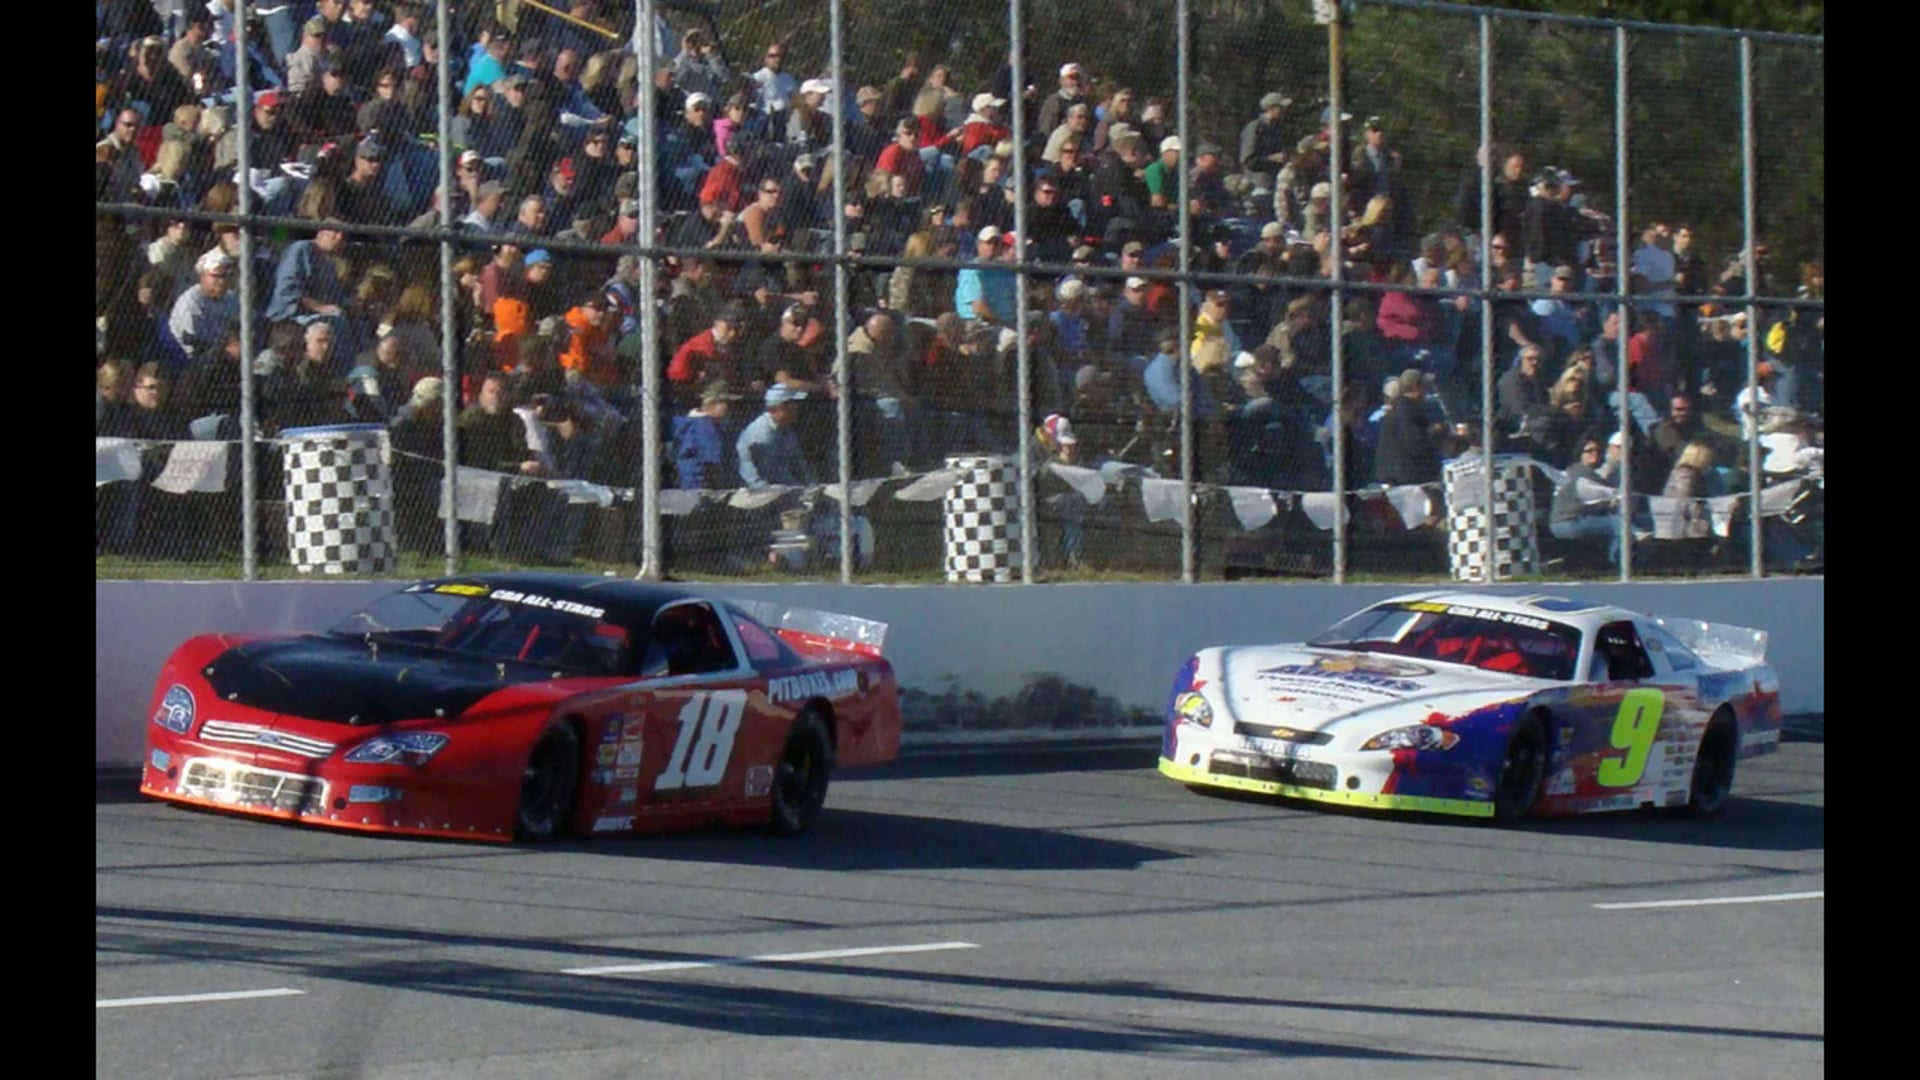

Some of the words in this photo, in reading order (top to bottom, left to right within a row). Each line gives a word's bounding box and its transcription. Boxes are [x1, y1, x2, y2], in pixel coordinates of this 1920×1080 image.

[522, 594, 606, 618] ALL-STARS
[1476, 609, 1550, 630] ALL-STARS
[654, 689, 748, 790] 18
[1597, 687, 1665, 787] 9
